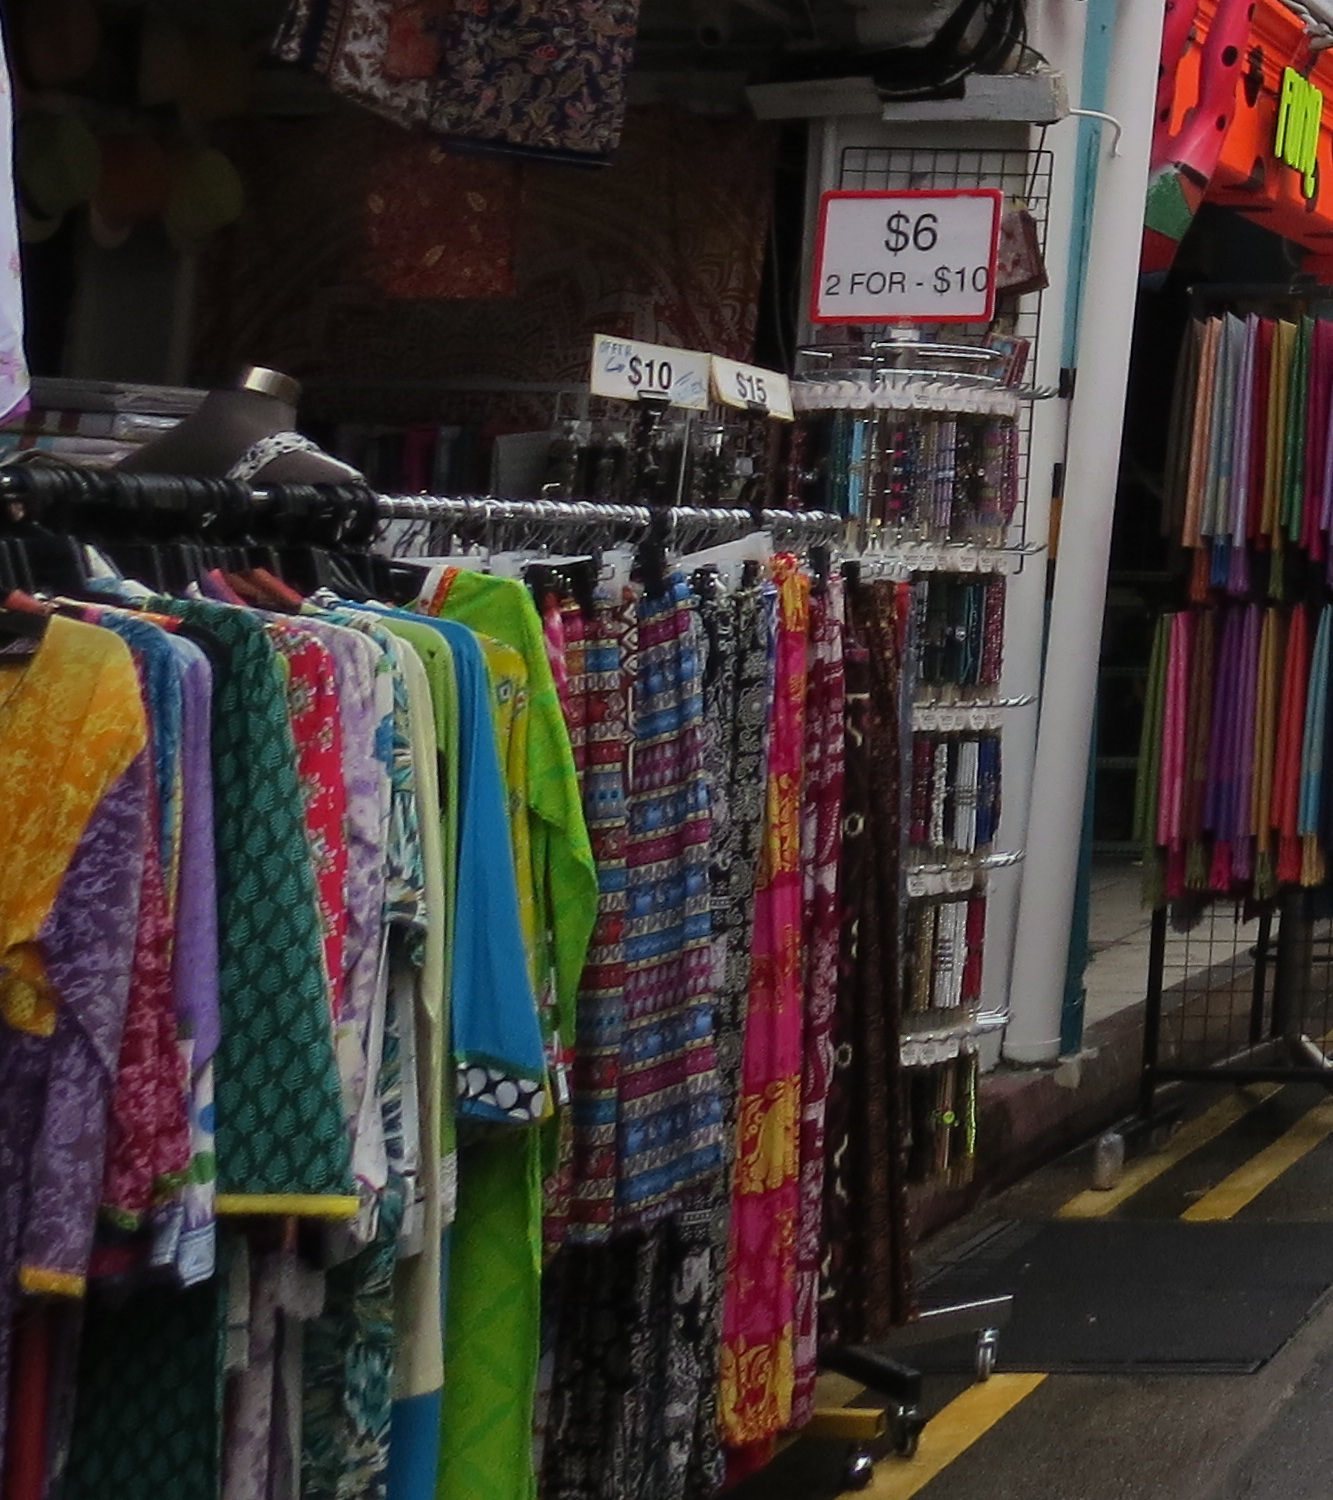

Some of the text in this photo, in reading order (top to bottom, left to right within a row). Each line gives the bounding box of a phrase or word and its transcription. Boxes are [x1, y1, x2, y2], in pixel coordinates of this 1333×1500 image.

[884, 211, 938, 257] $6
[825, 275, 841, 296] 2
[850, 271, 907, 296] FOR
[933, 265, 991, 296] $10
[628, 355, 672, 390] $10
[735, 370, 767, 403] $15
